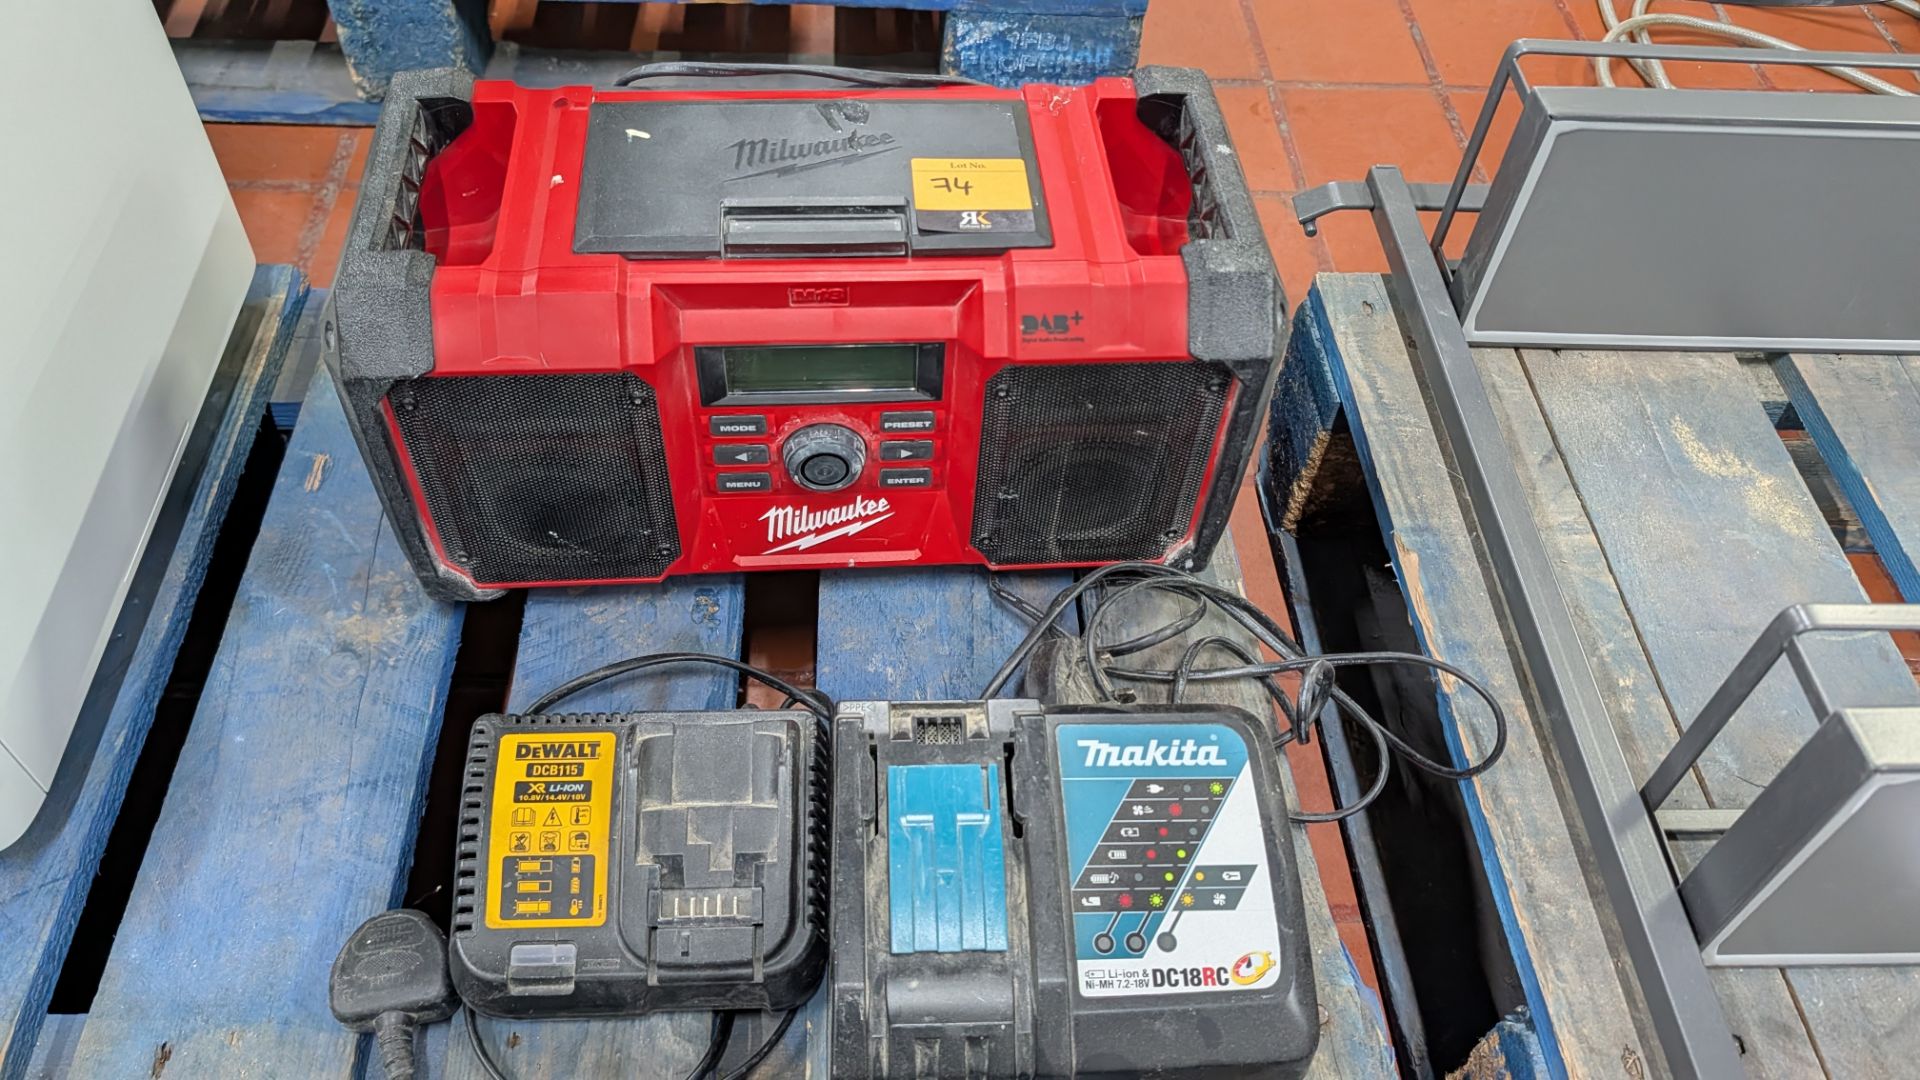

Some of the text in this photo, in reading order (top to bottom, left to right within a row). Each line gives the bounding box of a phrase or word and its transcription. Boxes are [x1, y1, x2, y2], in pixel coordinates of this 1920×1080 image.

[930, 177, 973, 196] 74
[884, 421, 932, 429] PRESET
[887, 477, 925, 485] ENTER
[758, 495, 890, 543] Milwaukee
[533, 765, 578, 776] DCB115
[527, 783, 584, 793] XR LI-ION
[1108, 969, 1149, 979] Li-ion &
[1152, 967, 1229, 987] DC18RC
[1085, 979, 1150, 989] Ni-MH 7.2-18V
